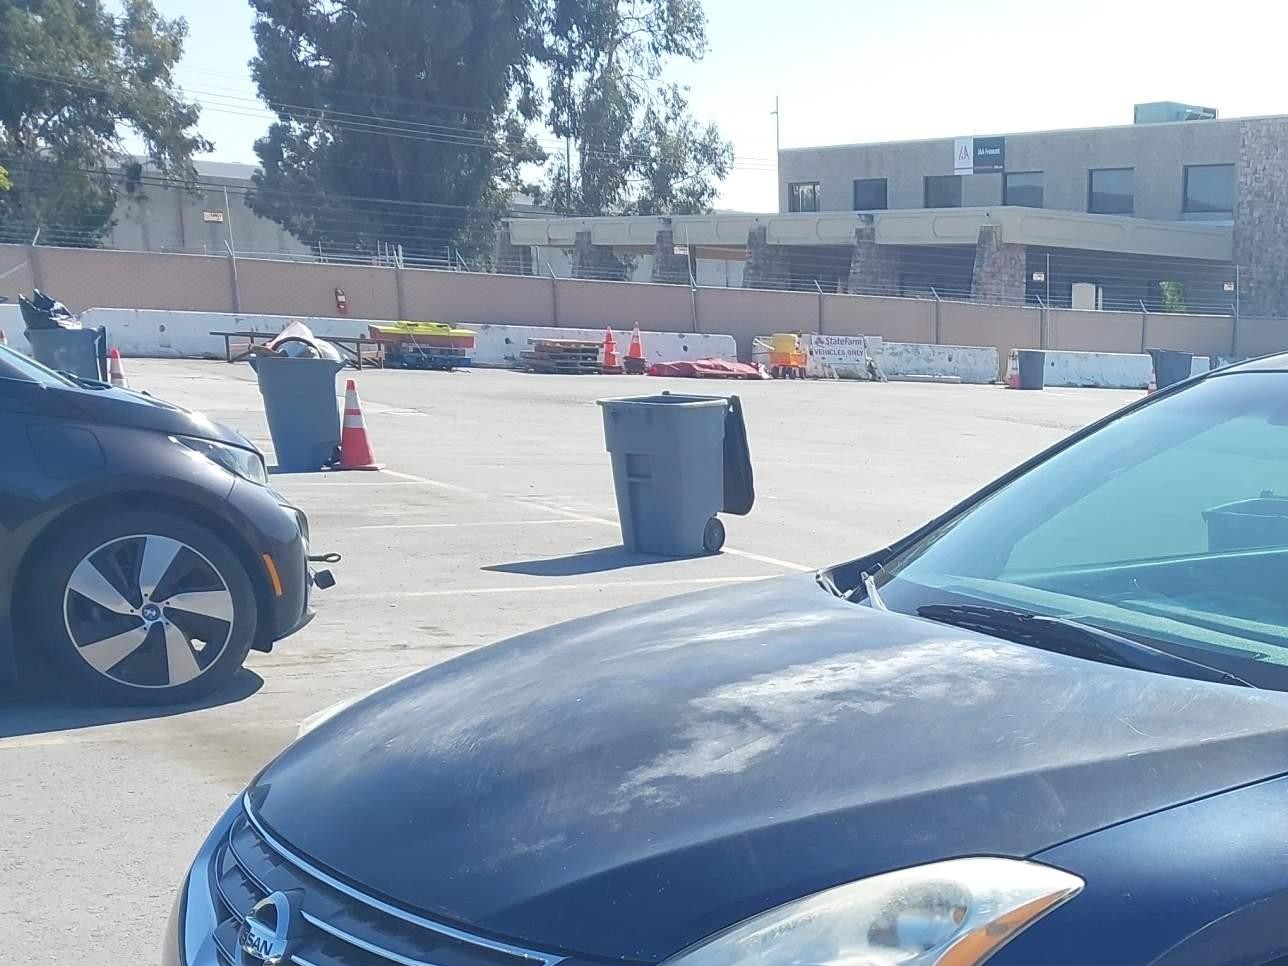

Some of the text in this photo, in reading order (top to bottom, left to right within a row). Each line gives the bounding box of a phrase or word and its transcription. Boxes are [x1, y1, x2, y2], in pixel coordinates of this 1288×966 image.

[825, 336, 862, 346] StateFarm
[814, 348, 864, 357] VEHICLES ONLY
[239, 928, 274, 956] SSAN
